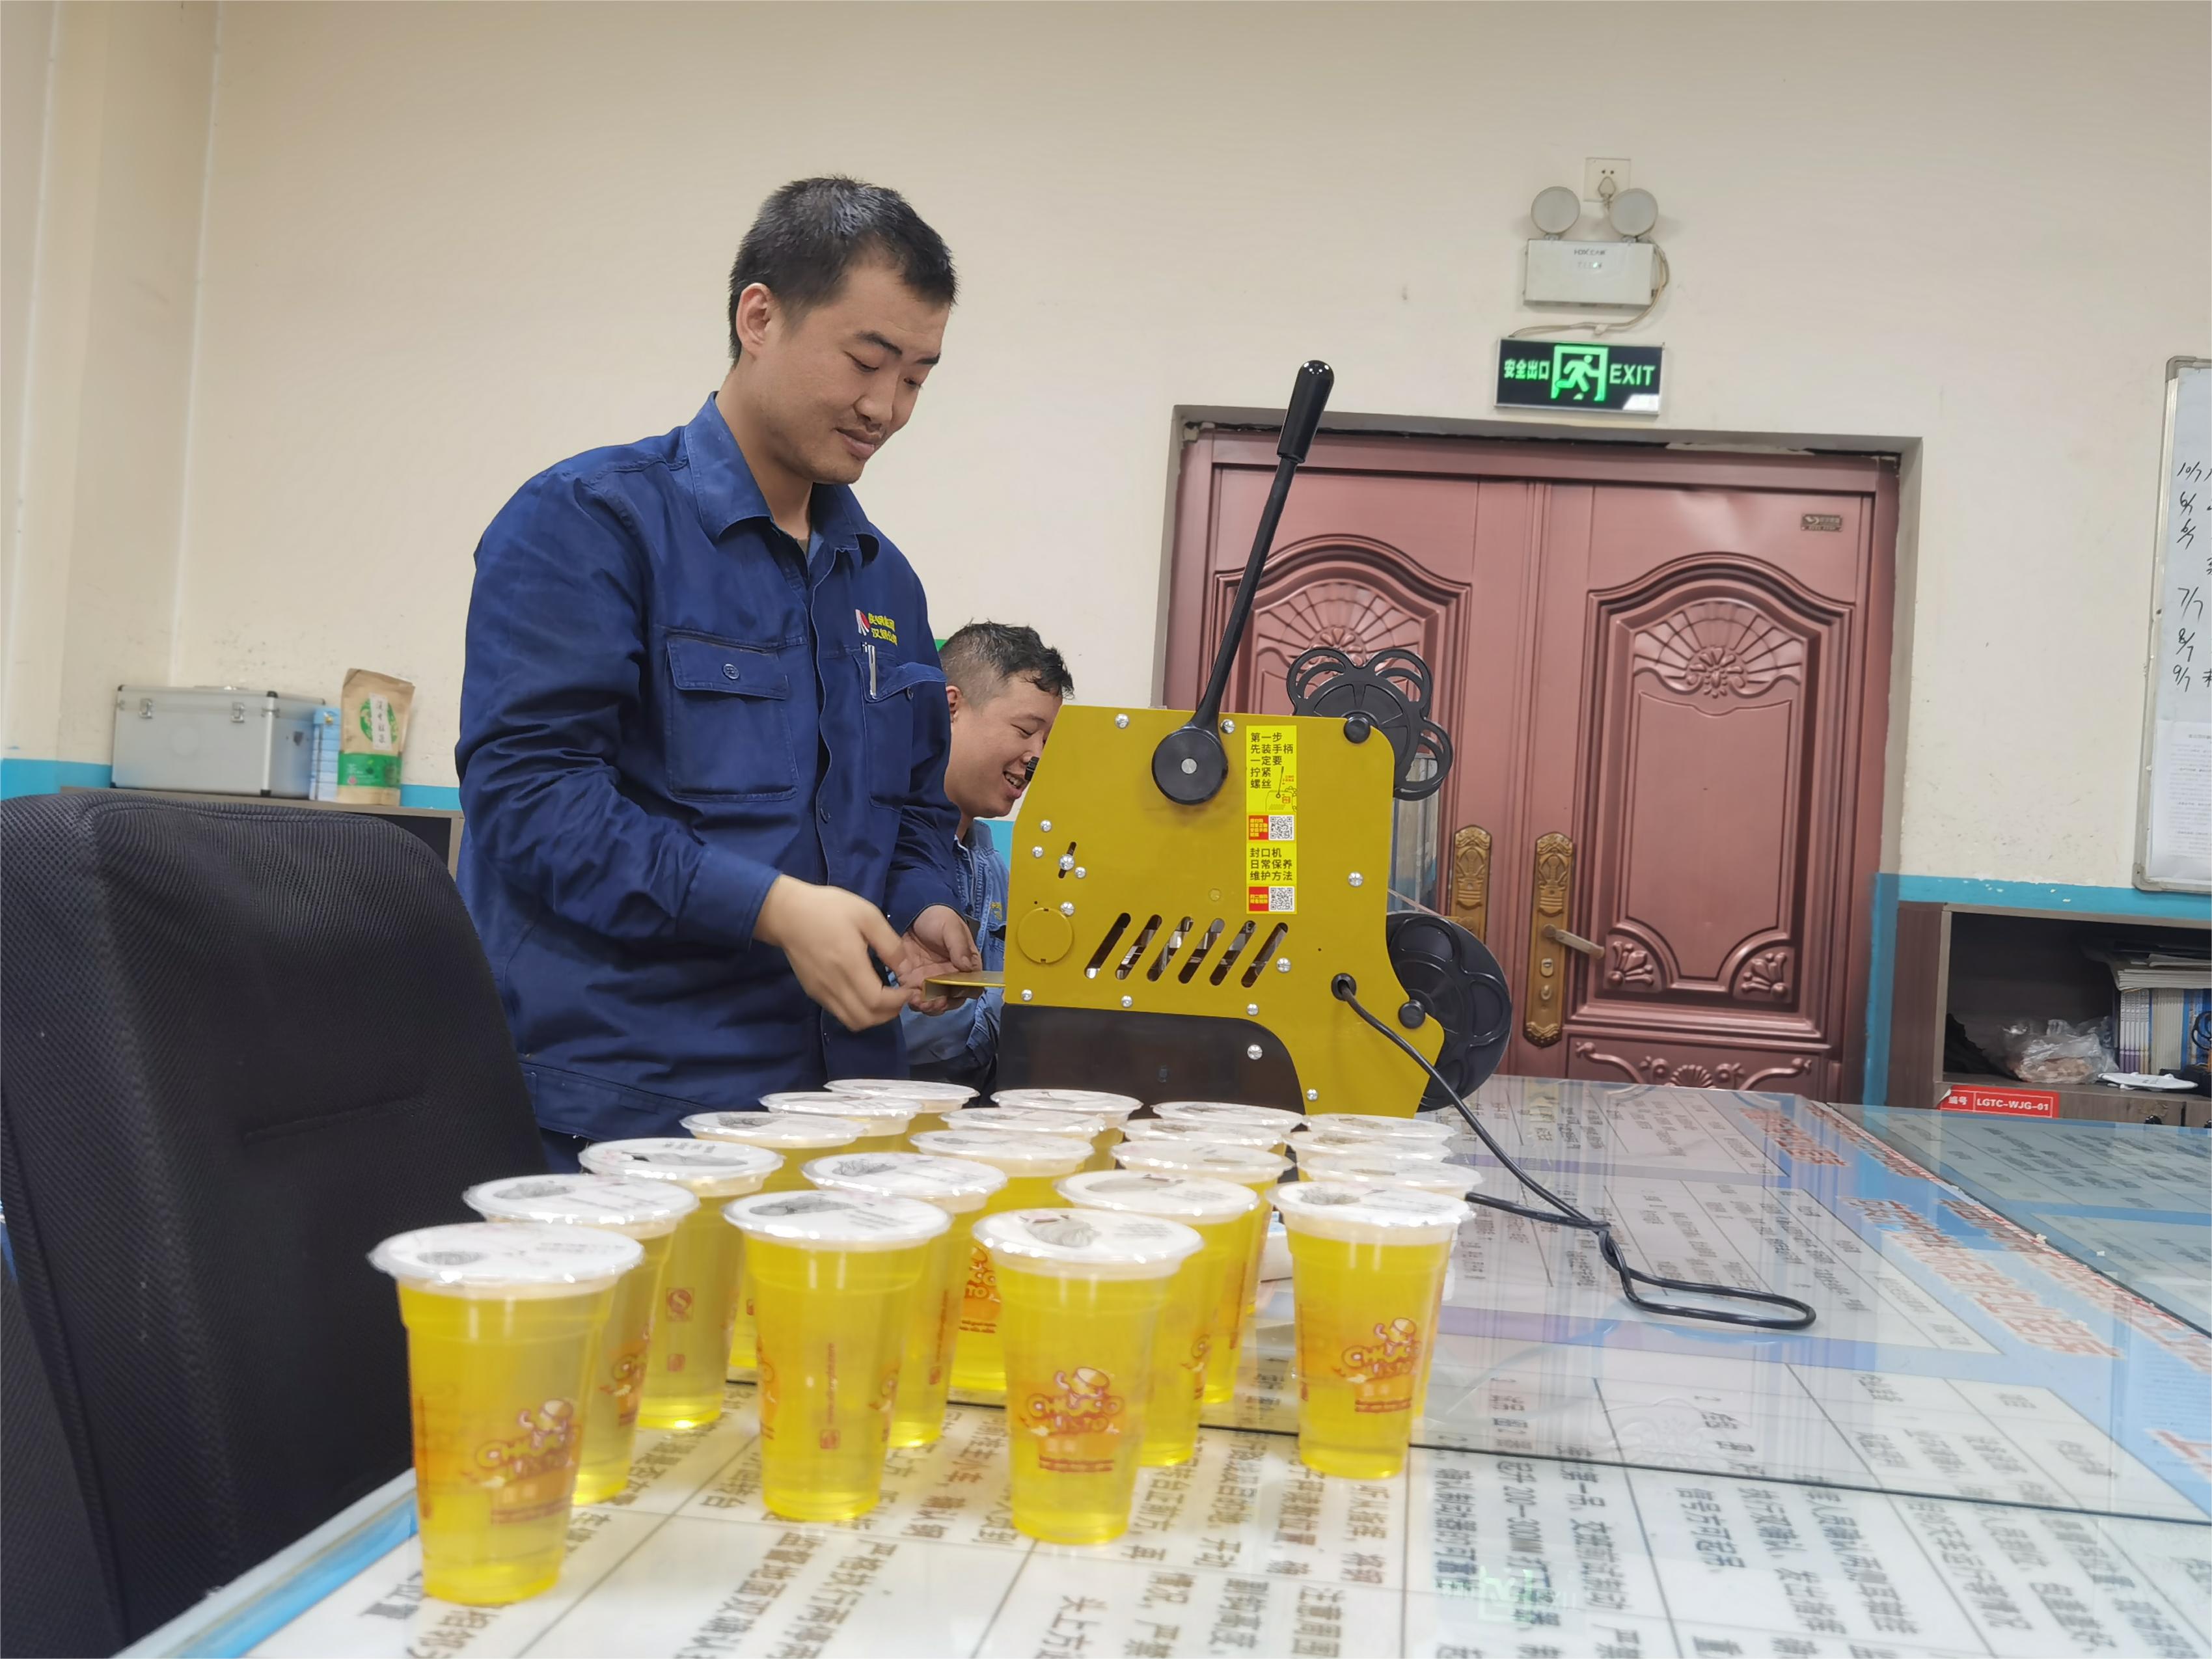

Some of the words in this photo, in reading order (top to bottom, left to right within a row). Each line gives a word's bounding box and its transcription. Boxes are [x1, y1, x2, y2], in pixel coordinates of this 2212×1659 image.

[1504, 358, 1550, 380] 安全出口
[1609, 363, 1656, 386] EXIT
[2177, 461, 2202, 483] 10/7
[2178, 586, 2204, 622] 7/7
[2176, 627, 2196, 663] 8/7
[2173, 665, 2191, 692] 9/7
[1250, 732, 1282, 743] 第一步
[1250, 743, 1294, 754] 先装手柄
[1250, 755, 1282, 766] 一定要
[1250, 767, 1272, 778] 拧紧
[1250, 778, 1272, 789] 螺丝
[1250, 847, 1282, 858] 封口机
[1250, 859, 1292, 870] 日常保养
[1250, 871, 1293, 881] 维护方法
[1977, 1098, 2049, 1111] LGTC-WJG-01
